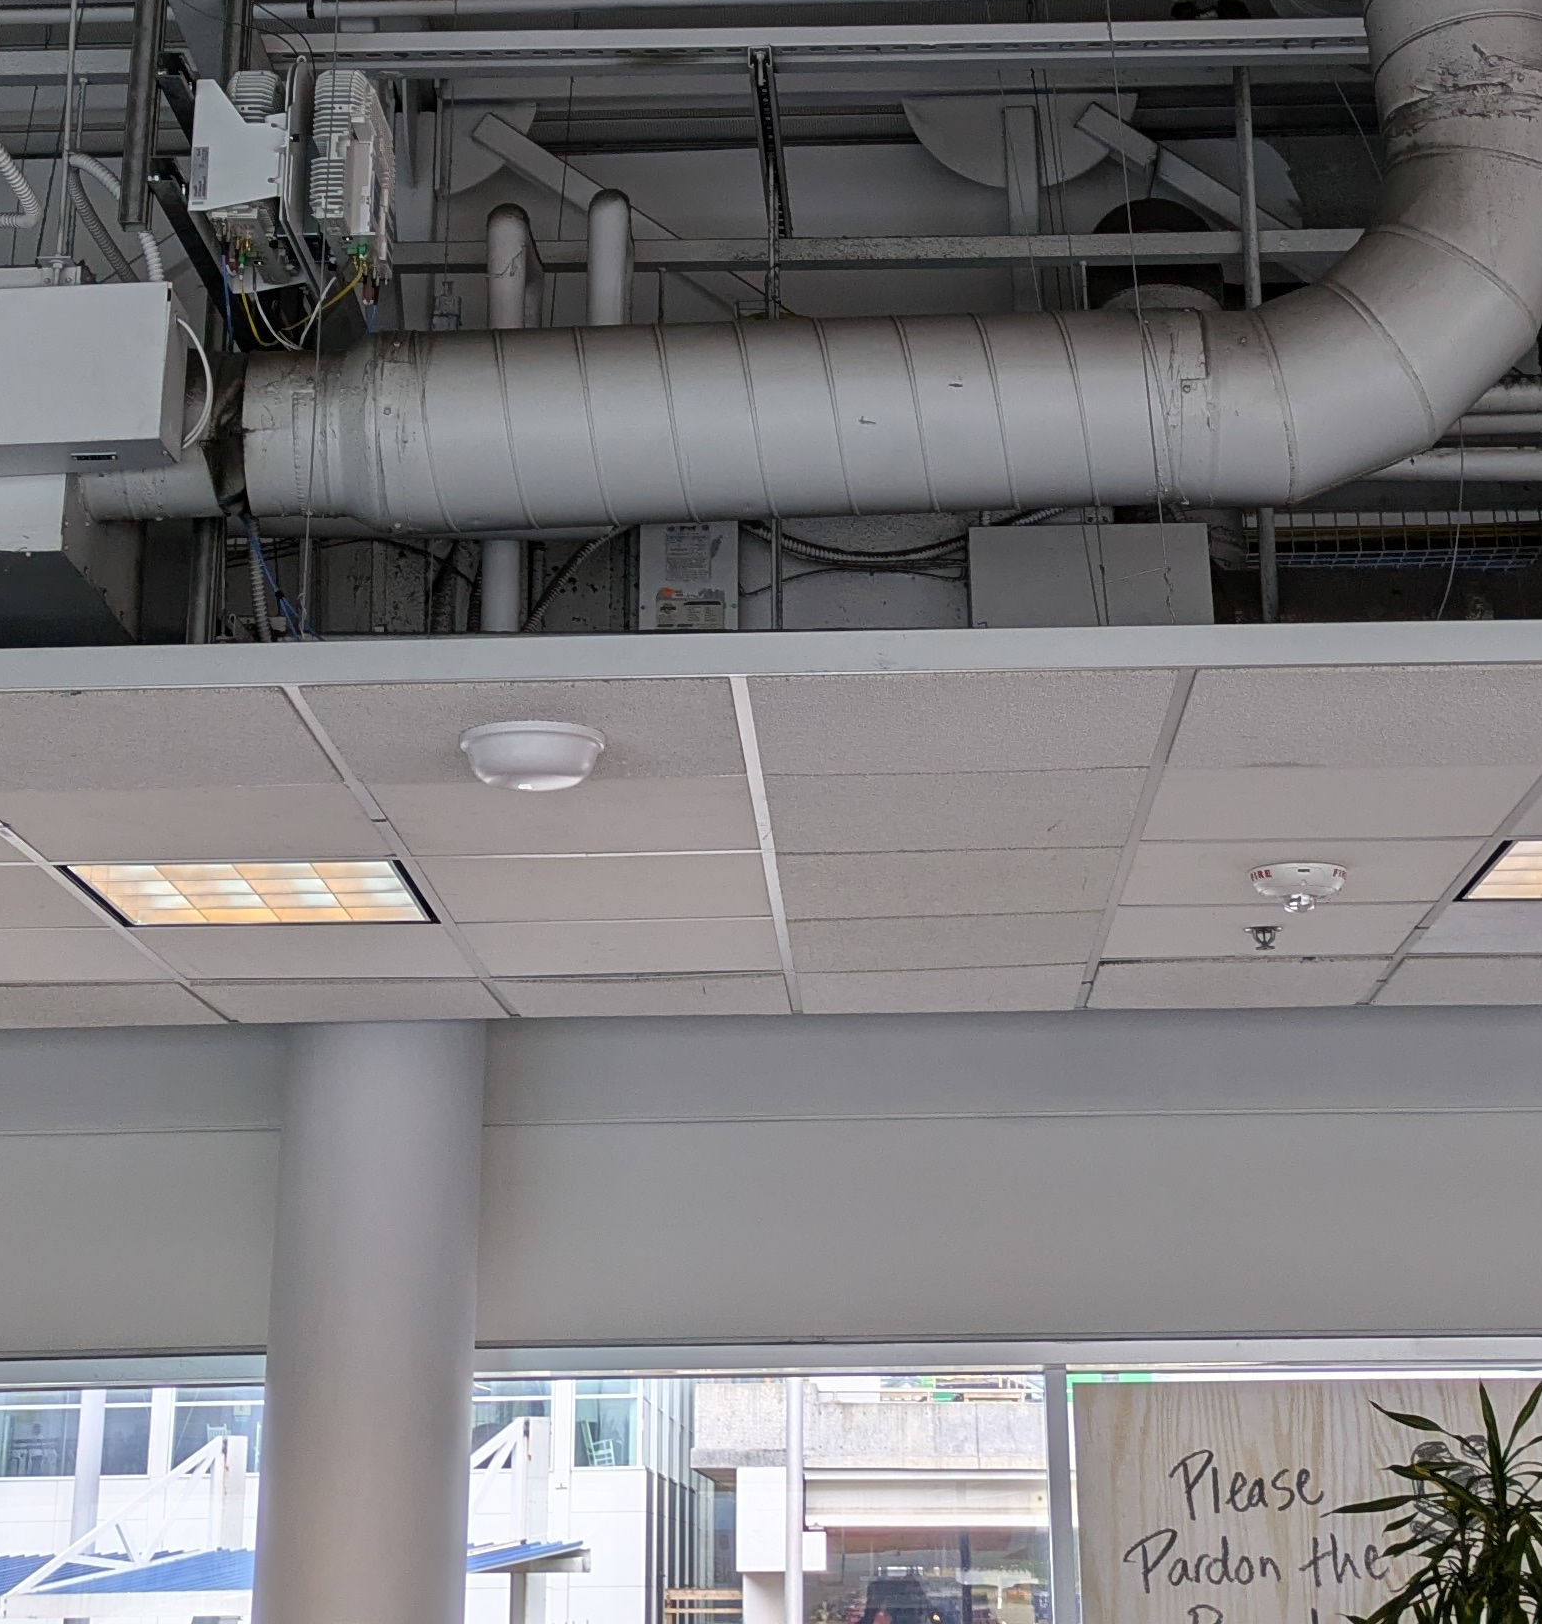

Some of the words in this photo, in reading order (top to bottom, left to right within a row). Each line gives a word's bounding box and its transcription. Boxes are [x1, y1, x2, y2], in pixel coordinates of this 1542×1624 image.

[1250, 869, 1273, 882] FIRE
[1168, 1448, 1325, 1521] Please
[1122, 1527, 1282, 1594] Pardon
[1298, 1532, 1390, 1588] the
